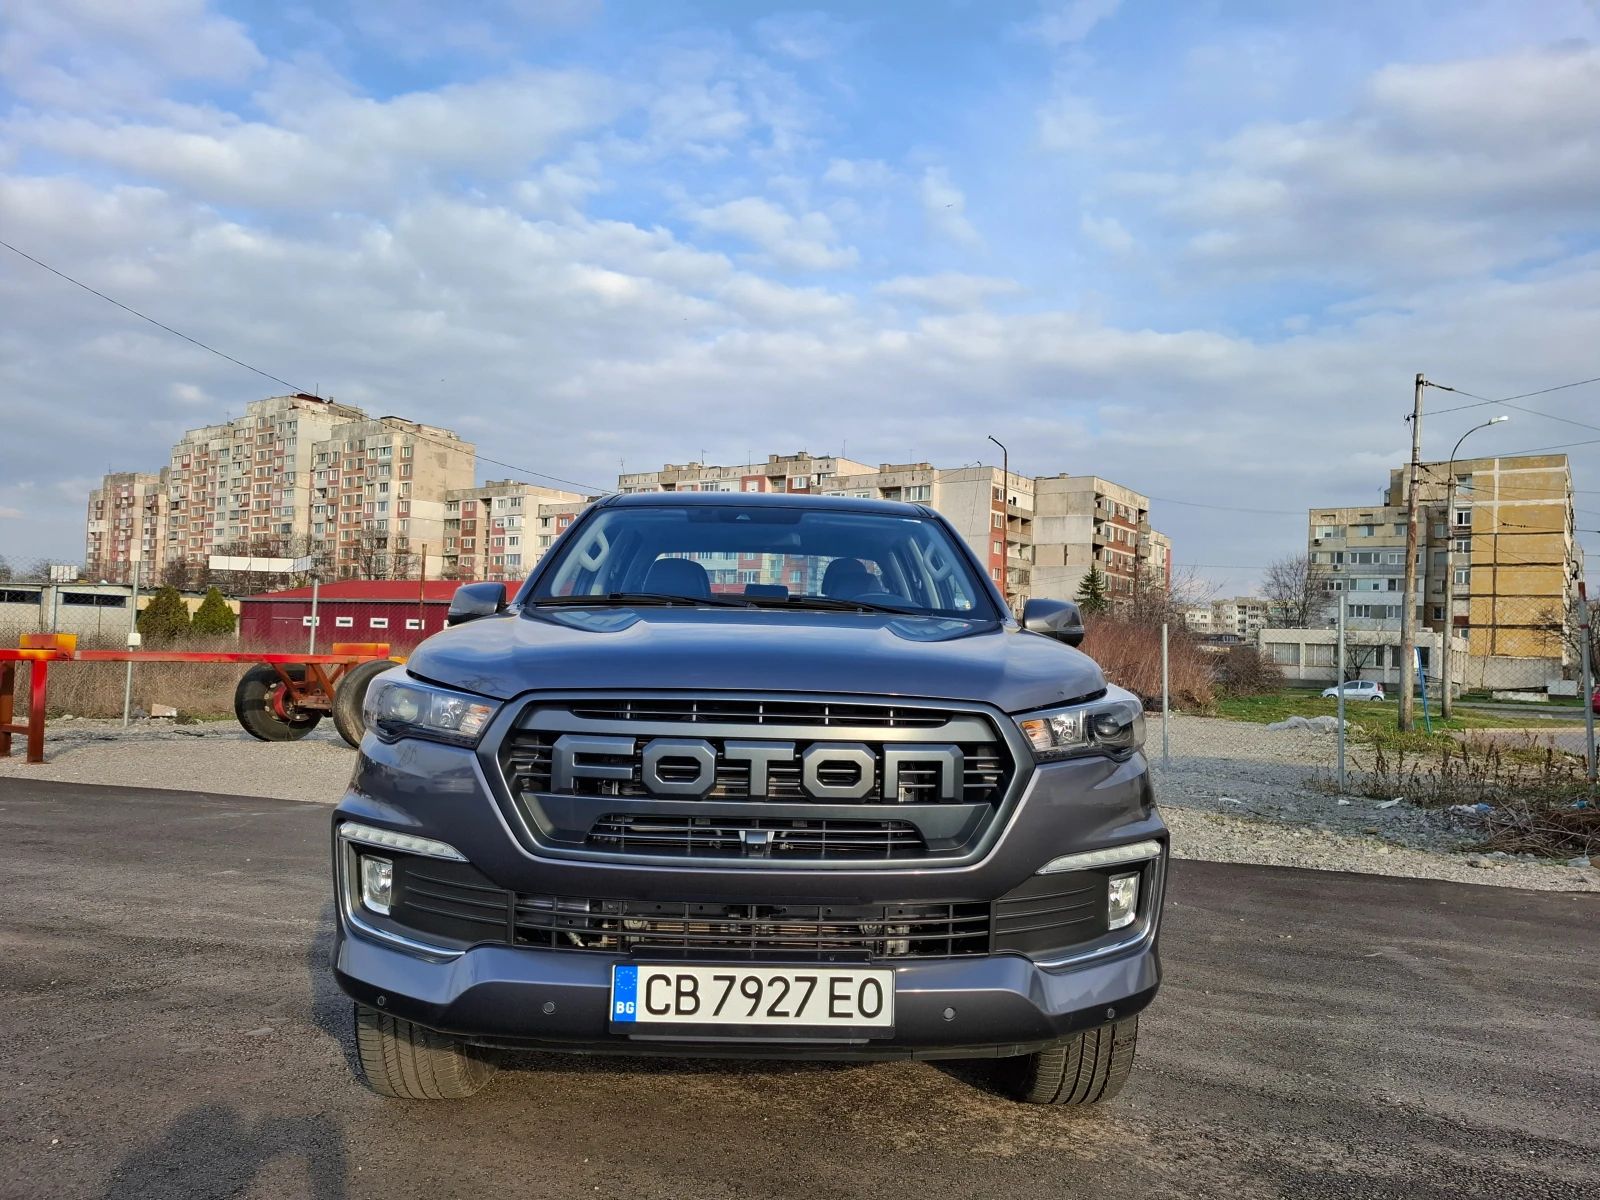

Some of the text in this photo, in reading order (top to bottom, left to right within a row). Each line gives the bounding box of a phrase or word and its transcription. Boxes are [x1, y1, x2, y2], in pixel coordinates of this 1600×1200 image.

[551, 734, 964, 804] FOTON
[616, 1001, 635, 1014] BG
[645, 974, 701, 1016] CB
[712, 975, 818, 1017] 7927
